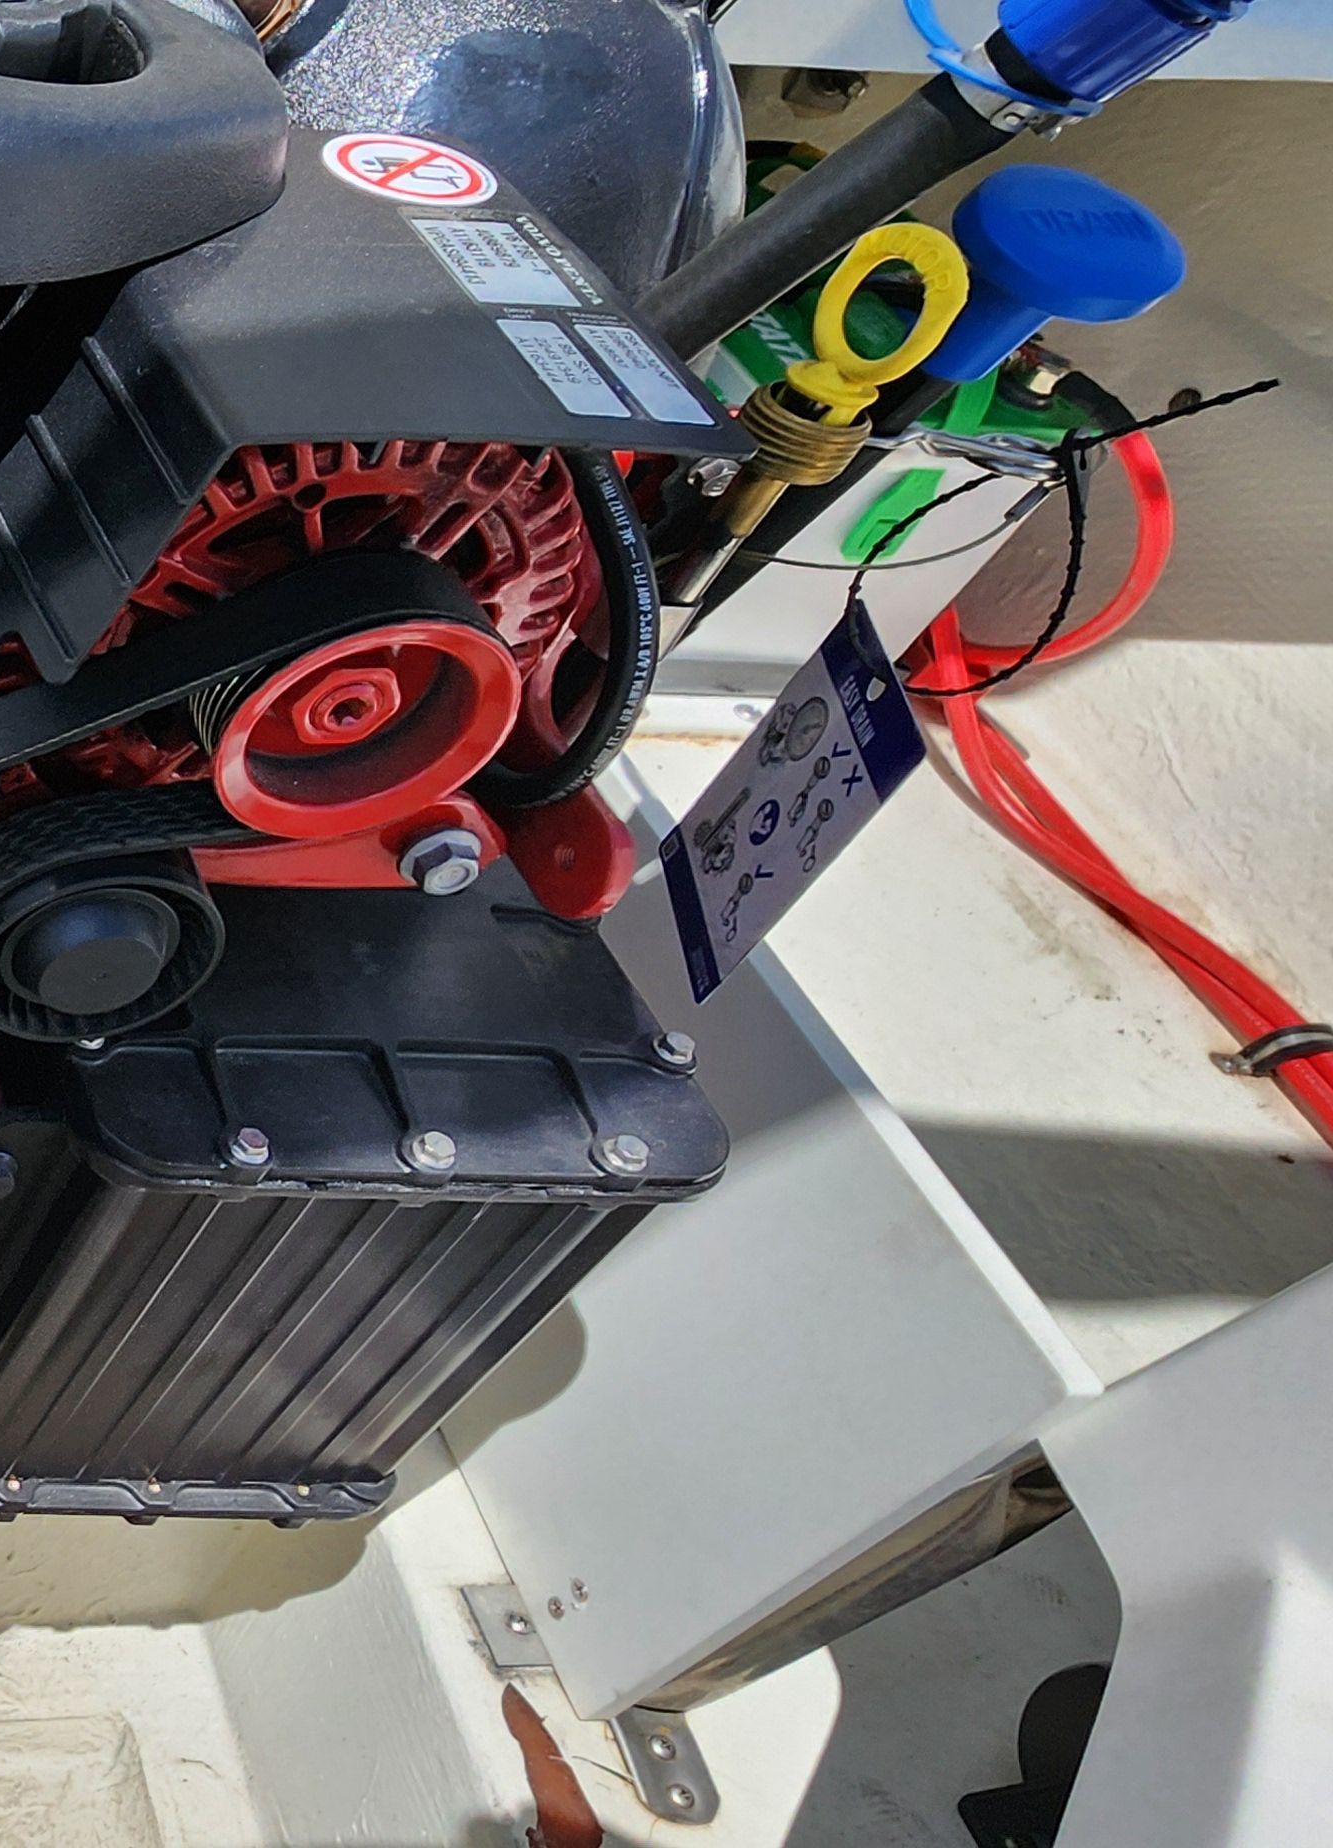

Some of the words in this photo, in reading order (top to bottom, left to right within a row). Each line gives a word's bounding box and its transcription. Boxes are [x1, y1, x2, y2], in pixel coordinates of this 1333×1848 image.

[516, 215, 561, 258] VOLVO
[555, 255, 603, 305] PENTA
[636, 612, 657, 646] 105°C
